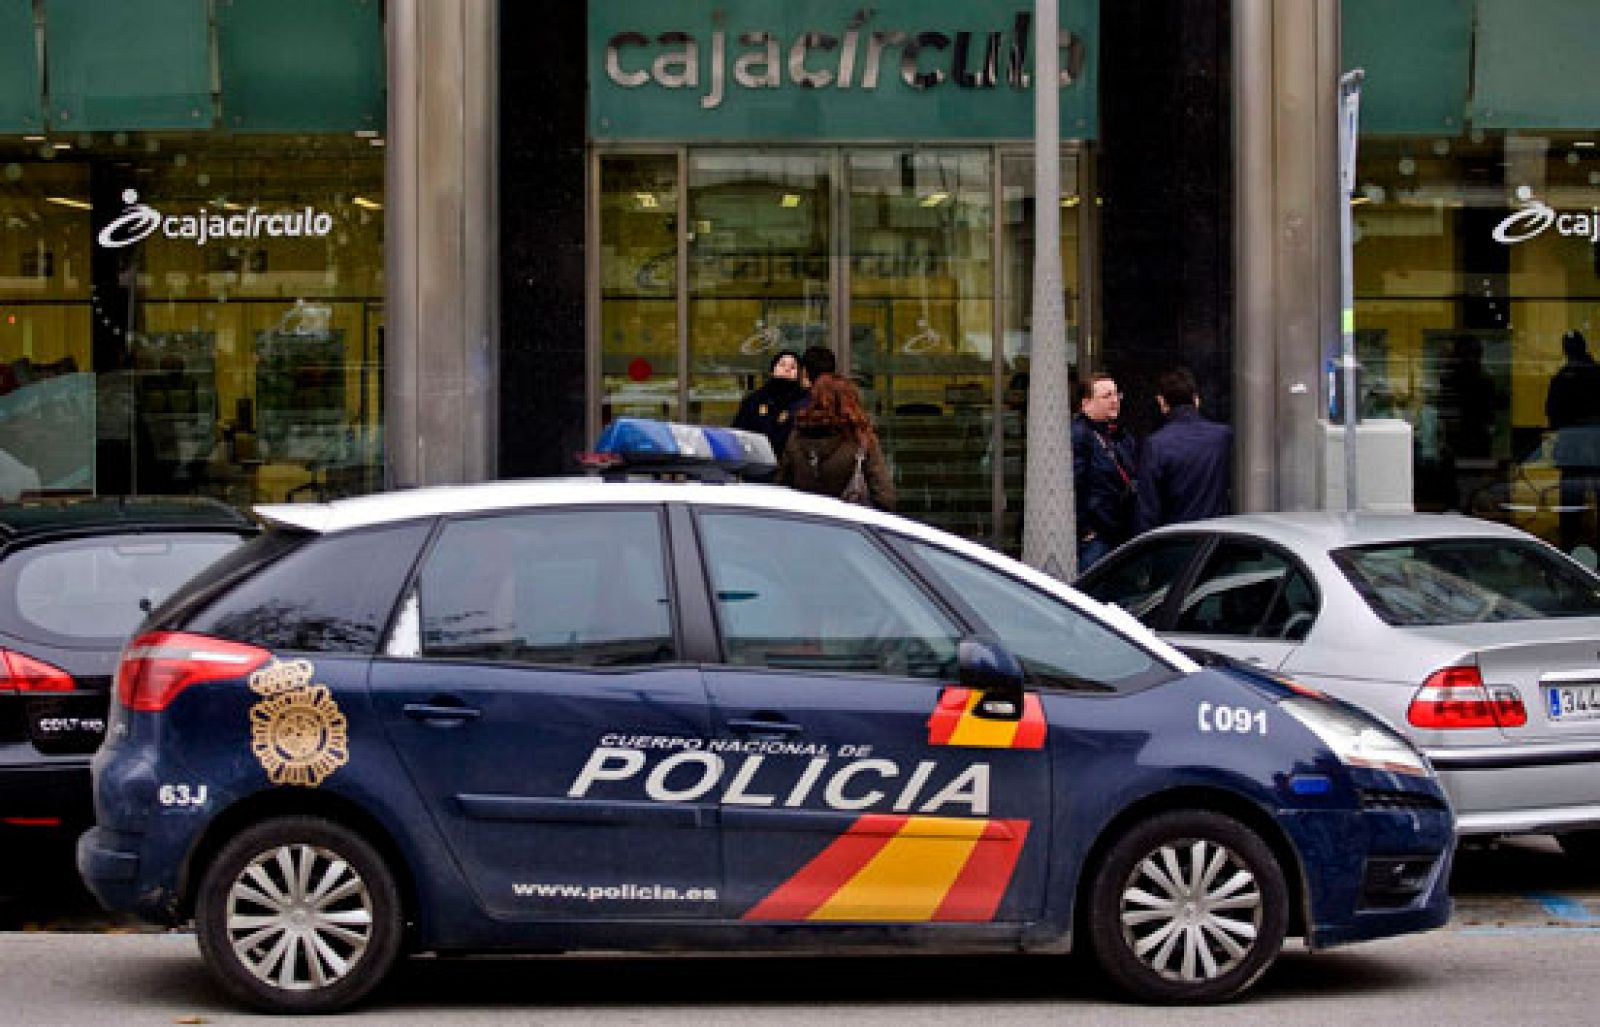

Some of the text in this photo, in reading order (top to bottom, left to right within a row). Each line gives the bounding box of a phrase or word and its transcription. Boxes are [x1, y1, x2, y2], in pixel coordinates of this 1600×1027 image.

[1557, 206, 1599, 243] caj
[601, 733, 874, 758] CUERPO NACIONAL DE
[567, 746, 991, 815] POLICIA
[159, 784, 208, 806] 63J
[511, 883, 718, 902] www.policia.es
